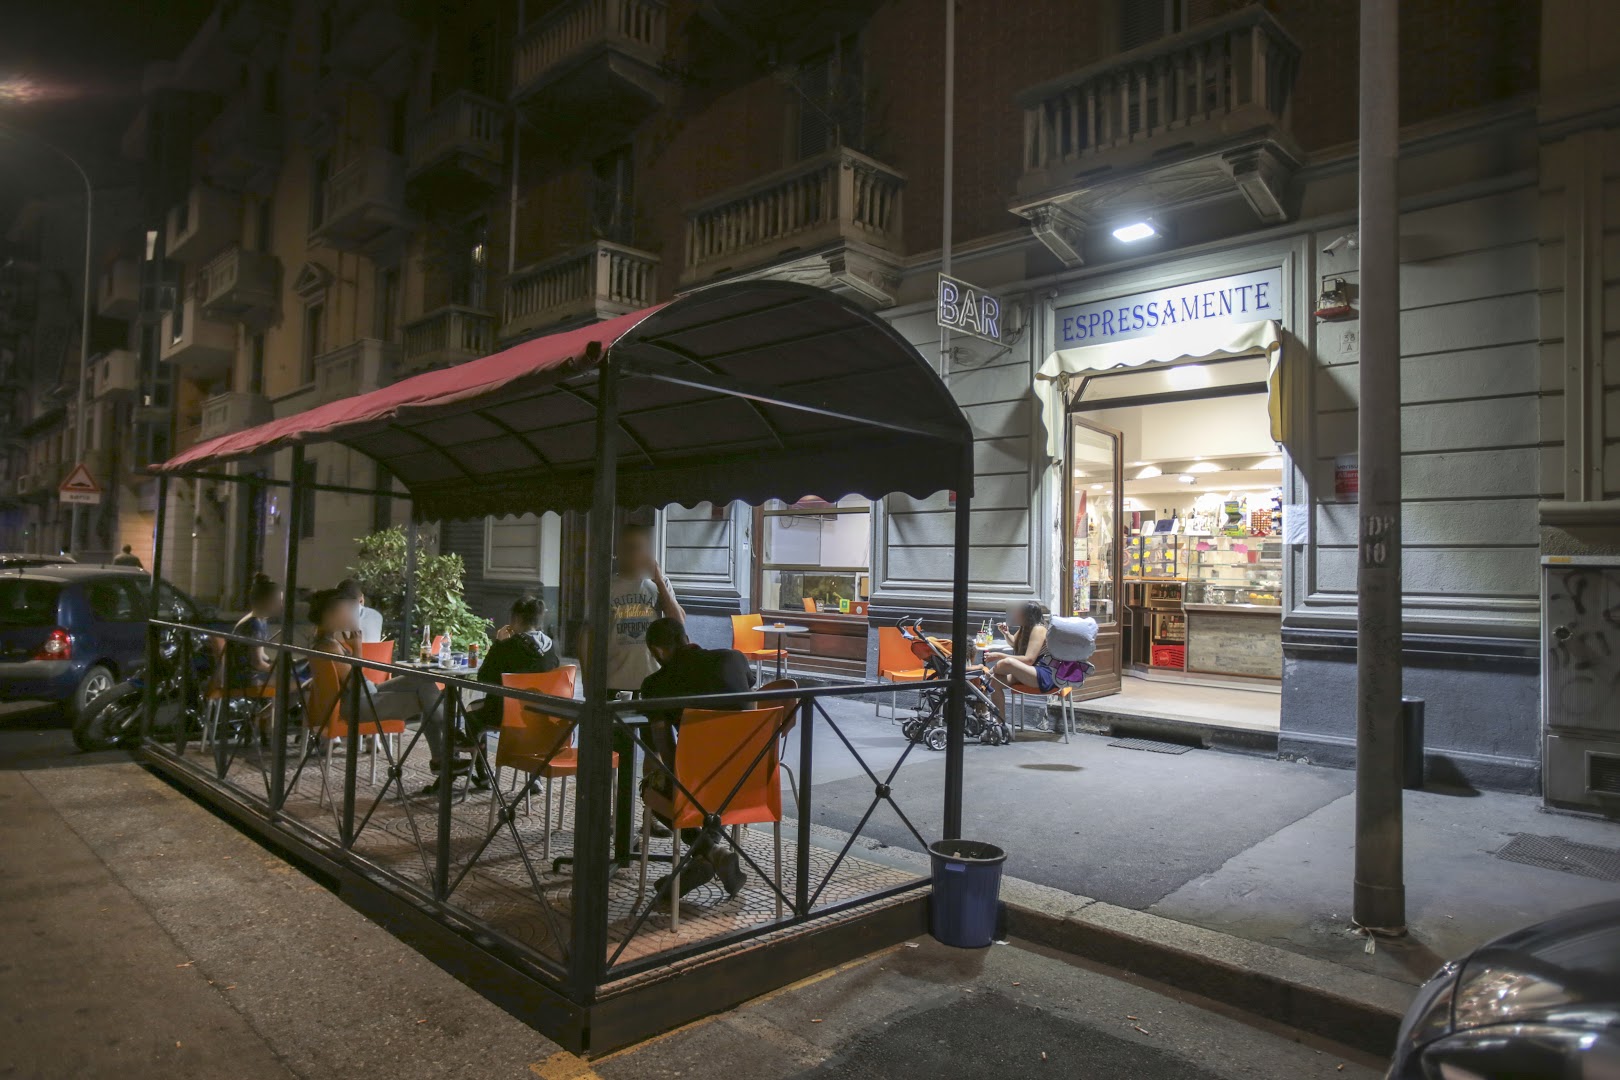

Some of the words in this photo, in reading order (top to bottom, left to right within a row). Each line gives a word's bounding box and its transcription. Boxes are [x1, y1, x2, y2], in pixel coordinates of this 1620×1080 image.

[941, 280, 999, 338] BAR
[1063, 282, 1270, 341] ESPRESSAMENTE
[1343, 333, 1355, 342] 38
[1346, 343, 1353, 351] A
[611, 593, 655, 608] RIGINA
[616, 621, 652, 634] EXPERIENC
